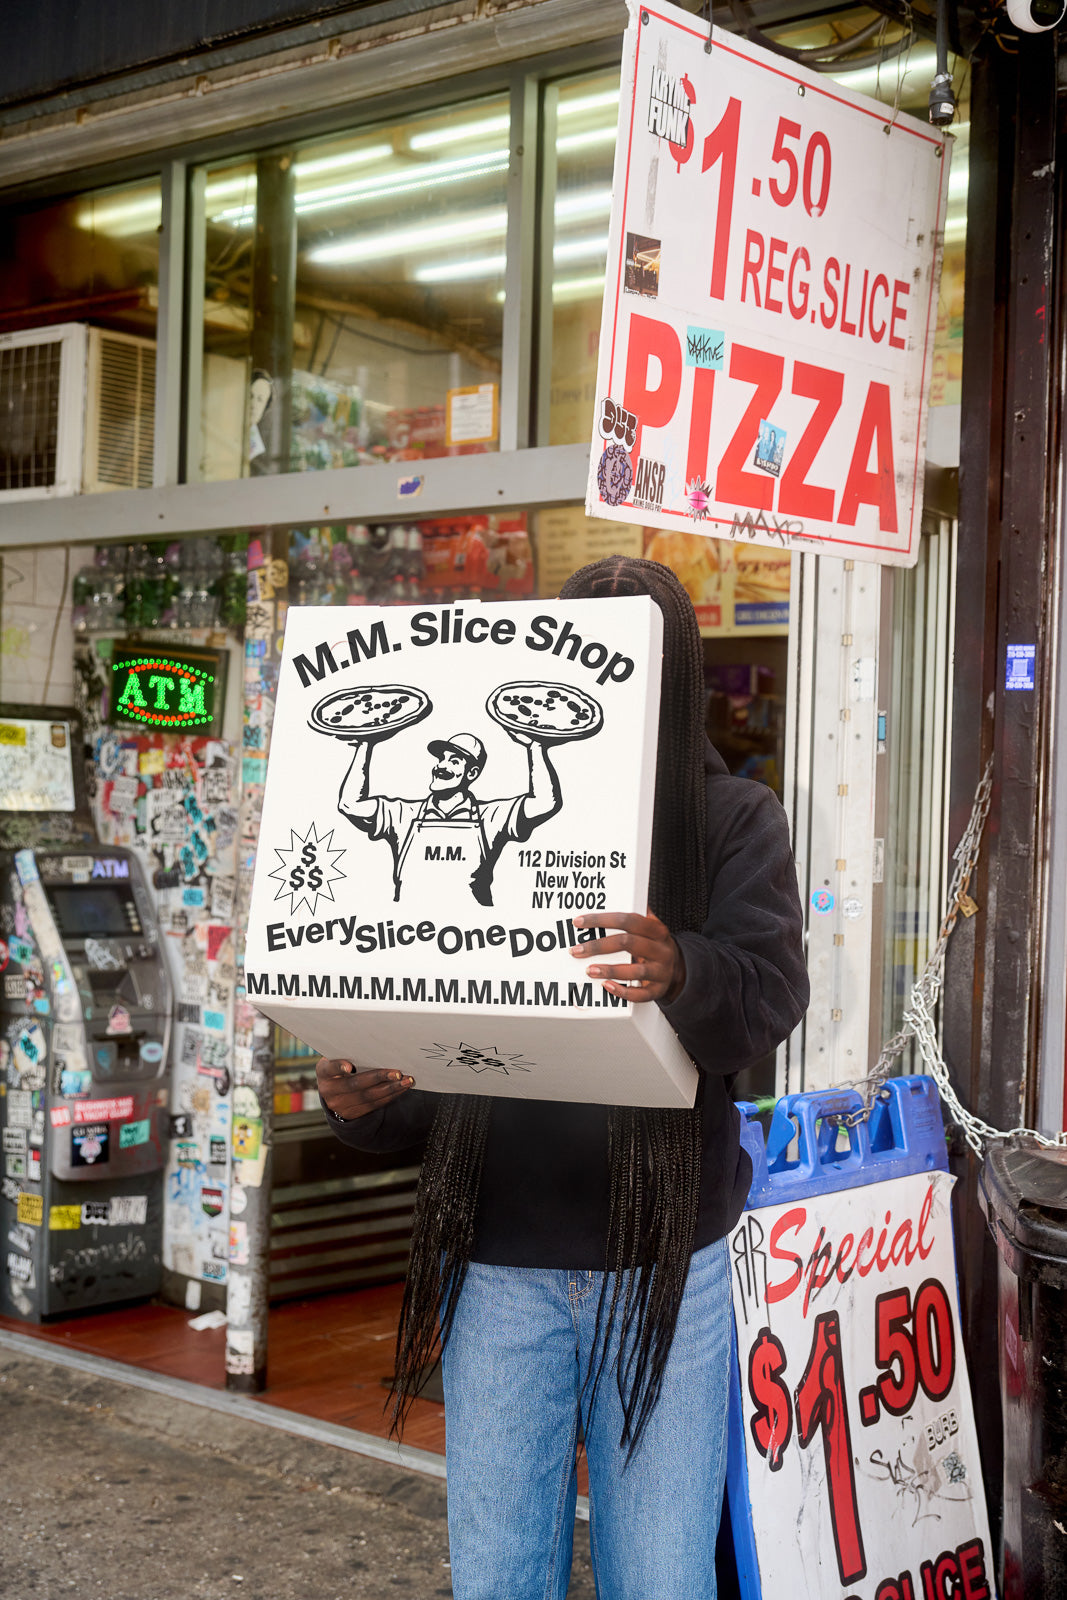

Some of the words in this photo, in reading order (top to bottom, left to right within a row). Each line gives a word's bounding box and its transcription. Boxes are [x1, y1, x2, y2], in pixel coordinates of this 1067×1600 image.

[623, 313, 899, 534] PIZZA
[634, 458, 665, 504] ANSR
[292, 621, 402, 688] M.M.
[411, 609, 517, 647] Slice
[526, 616, 635, 686] Shop
[118, 673, 207, 715] ATM
[424, 846, 467, 861] M.M.
[518, 851, 541, 868] 112
[546, 850, 605, 868] Division
[609, 851, 627, 868] St
[532, 892, 555, 909] NY
[558, 892, 606, 910] 10002
[535, 871, 569, 889] New
[572, 871, 606, 889] York
[764, 1184, 935, 1319] Special
